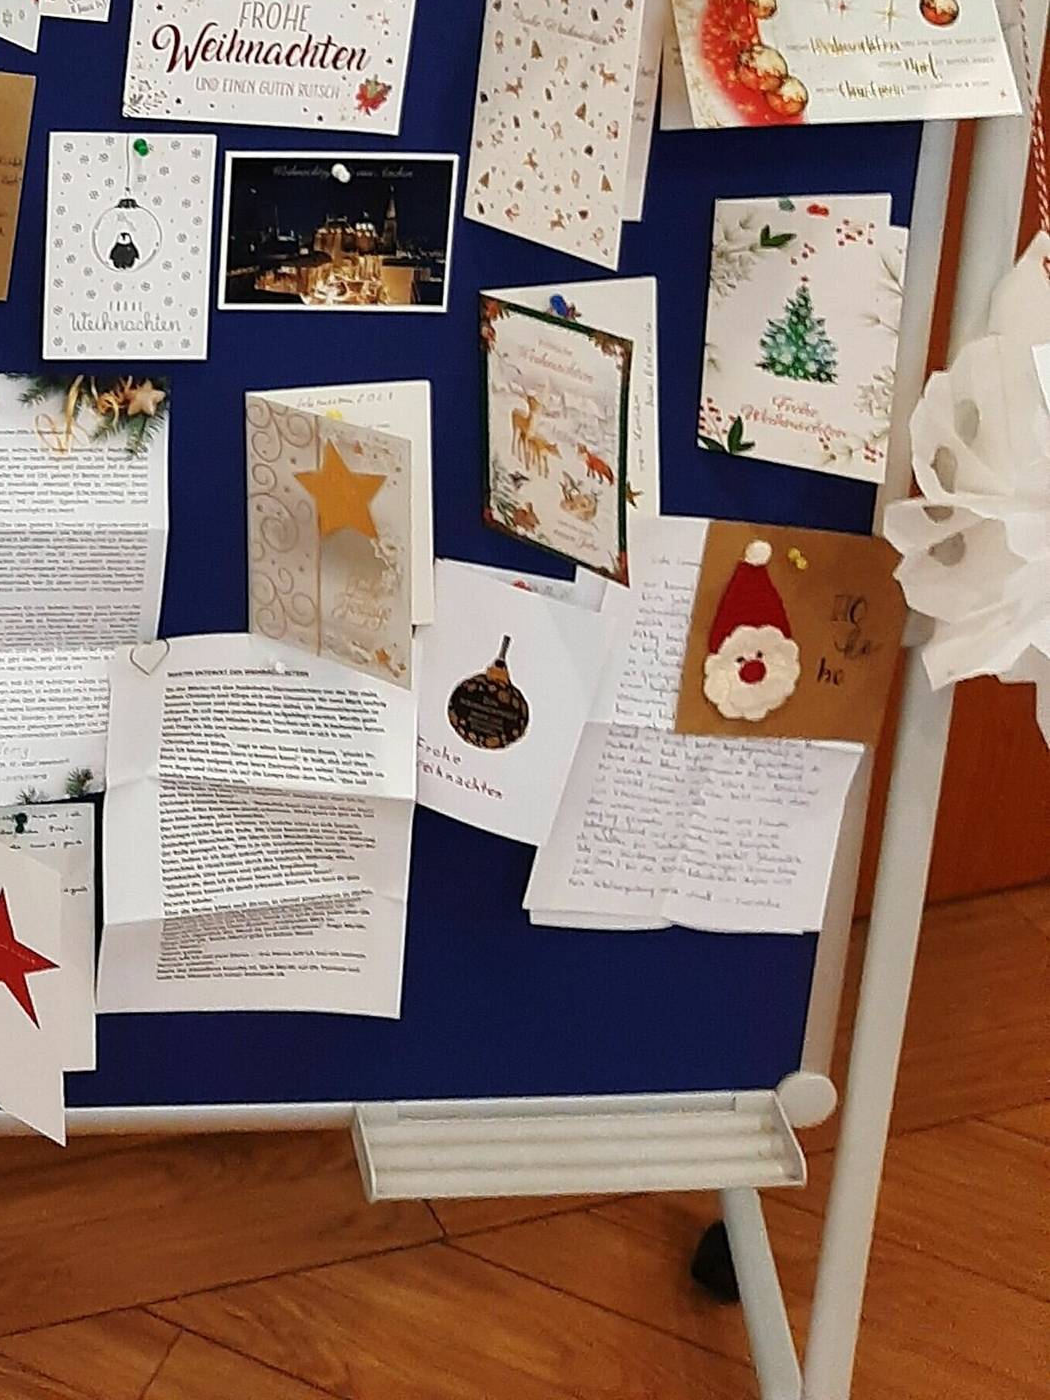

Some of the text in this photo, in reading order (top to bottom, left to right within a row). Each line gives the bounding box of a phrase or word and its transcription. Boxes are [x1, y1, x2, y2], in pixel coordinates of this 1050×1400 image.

[239, 2, 311, 32] FROHE
[152, 22, 368, 73] Weihnachten
[196, 77, 219, 91] UND
[223, 79, 255, 93] EINEN
[259, 81, 294, 97] GUTEN
